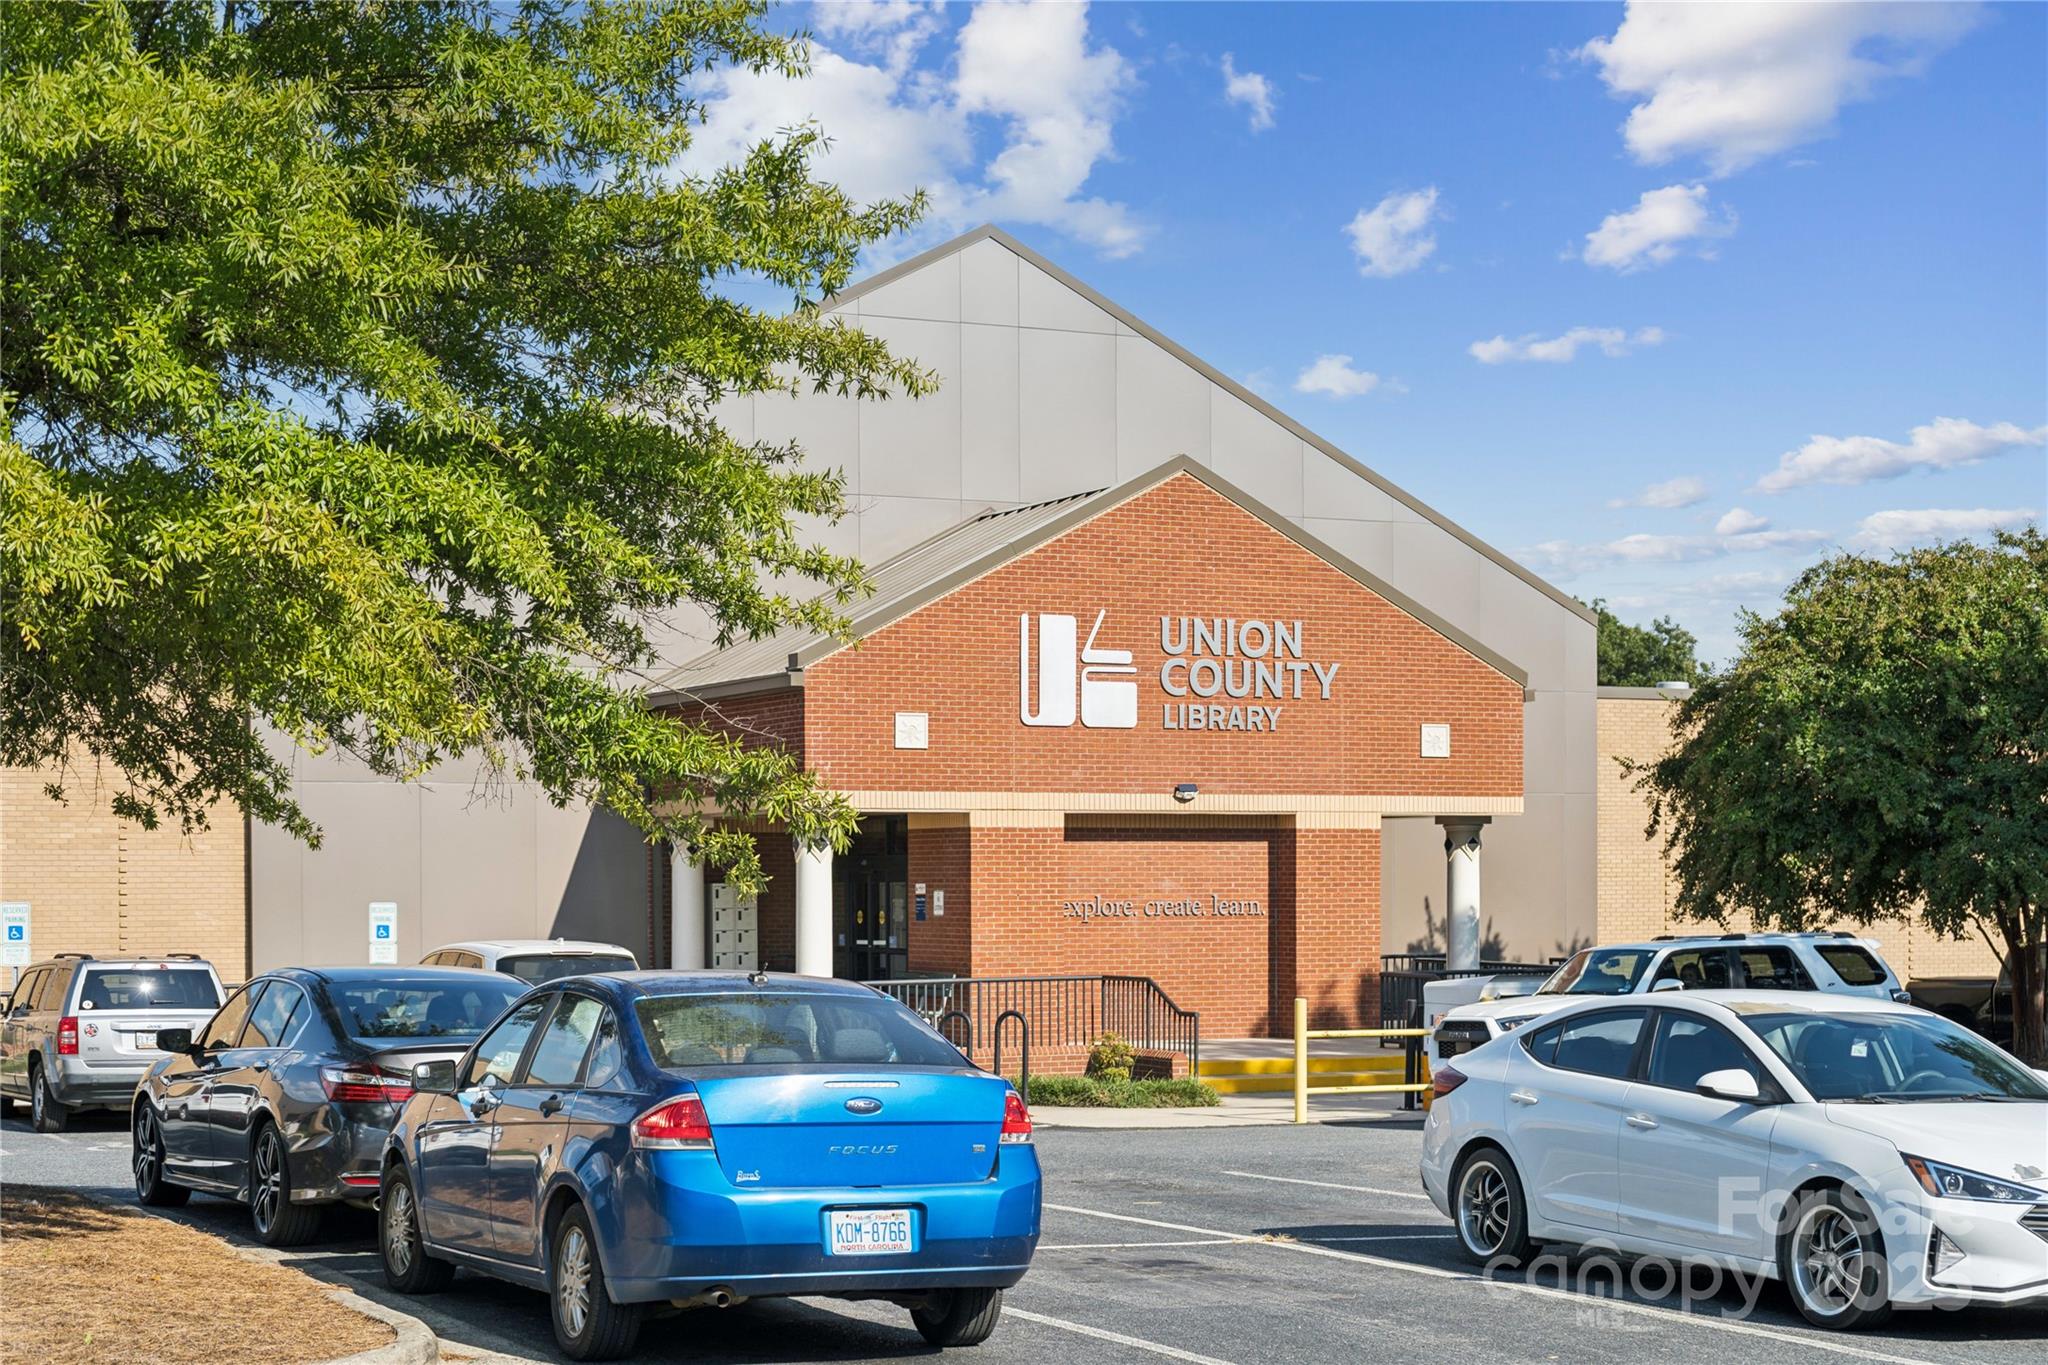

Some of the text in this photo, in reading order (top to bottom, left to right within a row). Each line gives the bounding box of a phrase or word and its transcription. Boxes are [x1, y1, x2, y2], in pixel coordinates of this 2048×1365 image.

[1160, 616, 1302, 659] UNION
[1160, 658, 1341, 699] COUNTY
[1162, 703, 1283, 731] LIBRARY
[1064, 894, 1266, 924] explore. create. learn.
[828, 1144, 899, 1155] FOCUS
